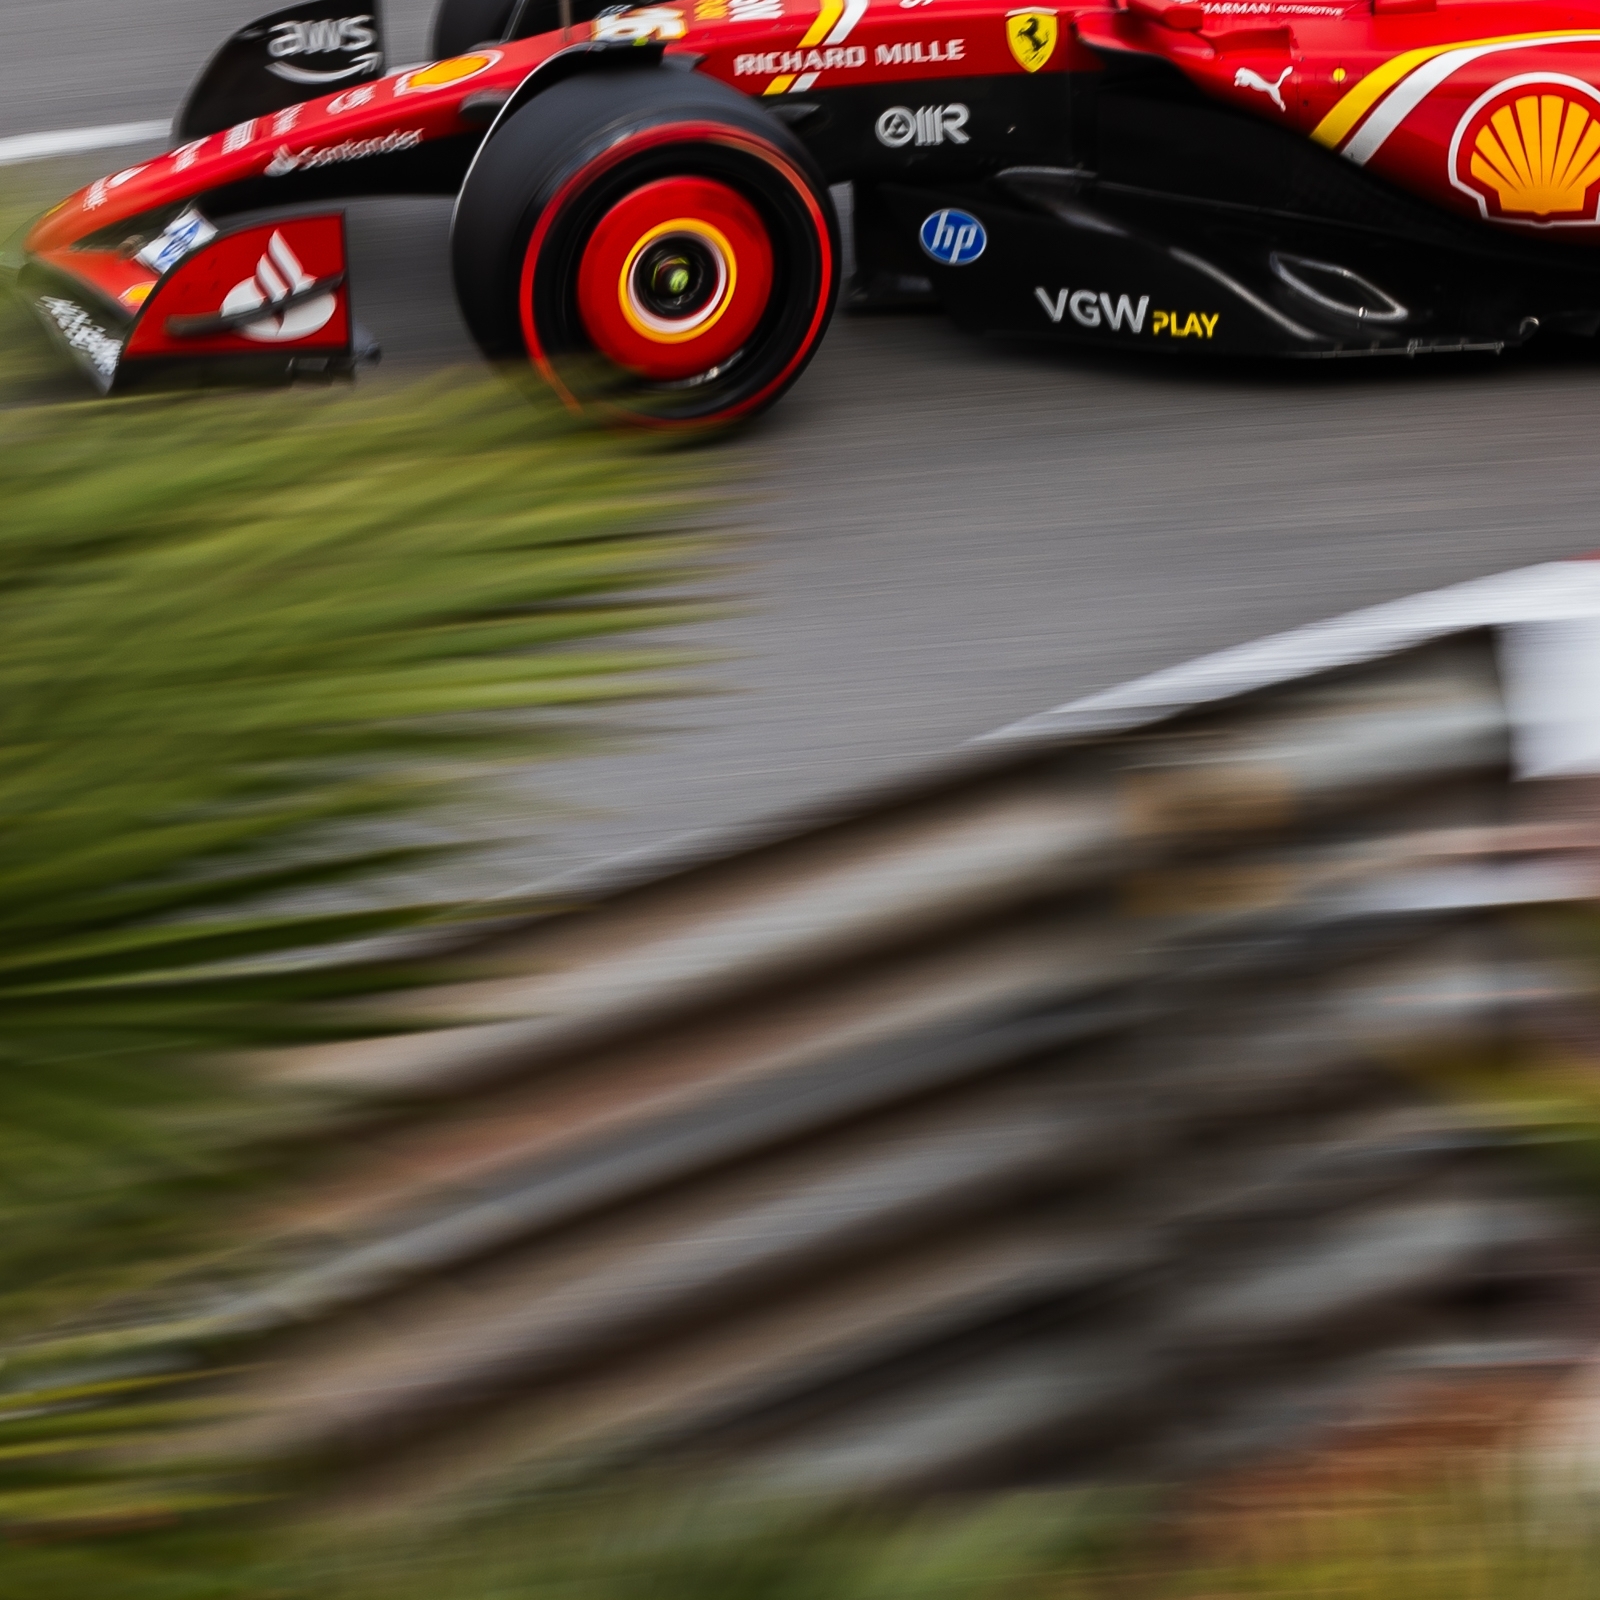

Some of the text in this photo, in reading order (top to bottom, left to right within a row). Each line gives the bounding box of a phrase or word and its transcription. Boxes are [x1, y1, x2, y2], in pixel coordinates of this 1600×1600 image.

[1275, 5, 1345, 17] AUTOMOTIVE
[267, 14, 375, 58] aws
[734, 39, 966, 76] RICHARD MILLE
[929, 210, 977, 264] hp
[1035, 287, 1219, 338] VGW PLAY
